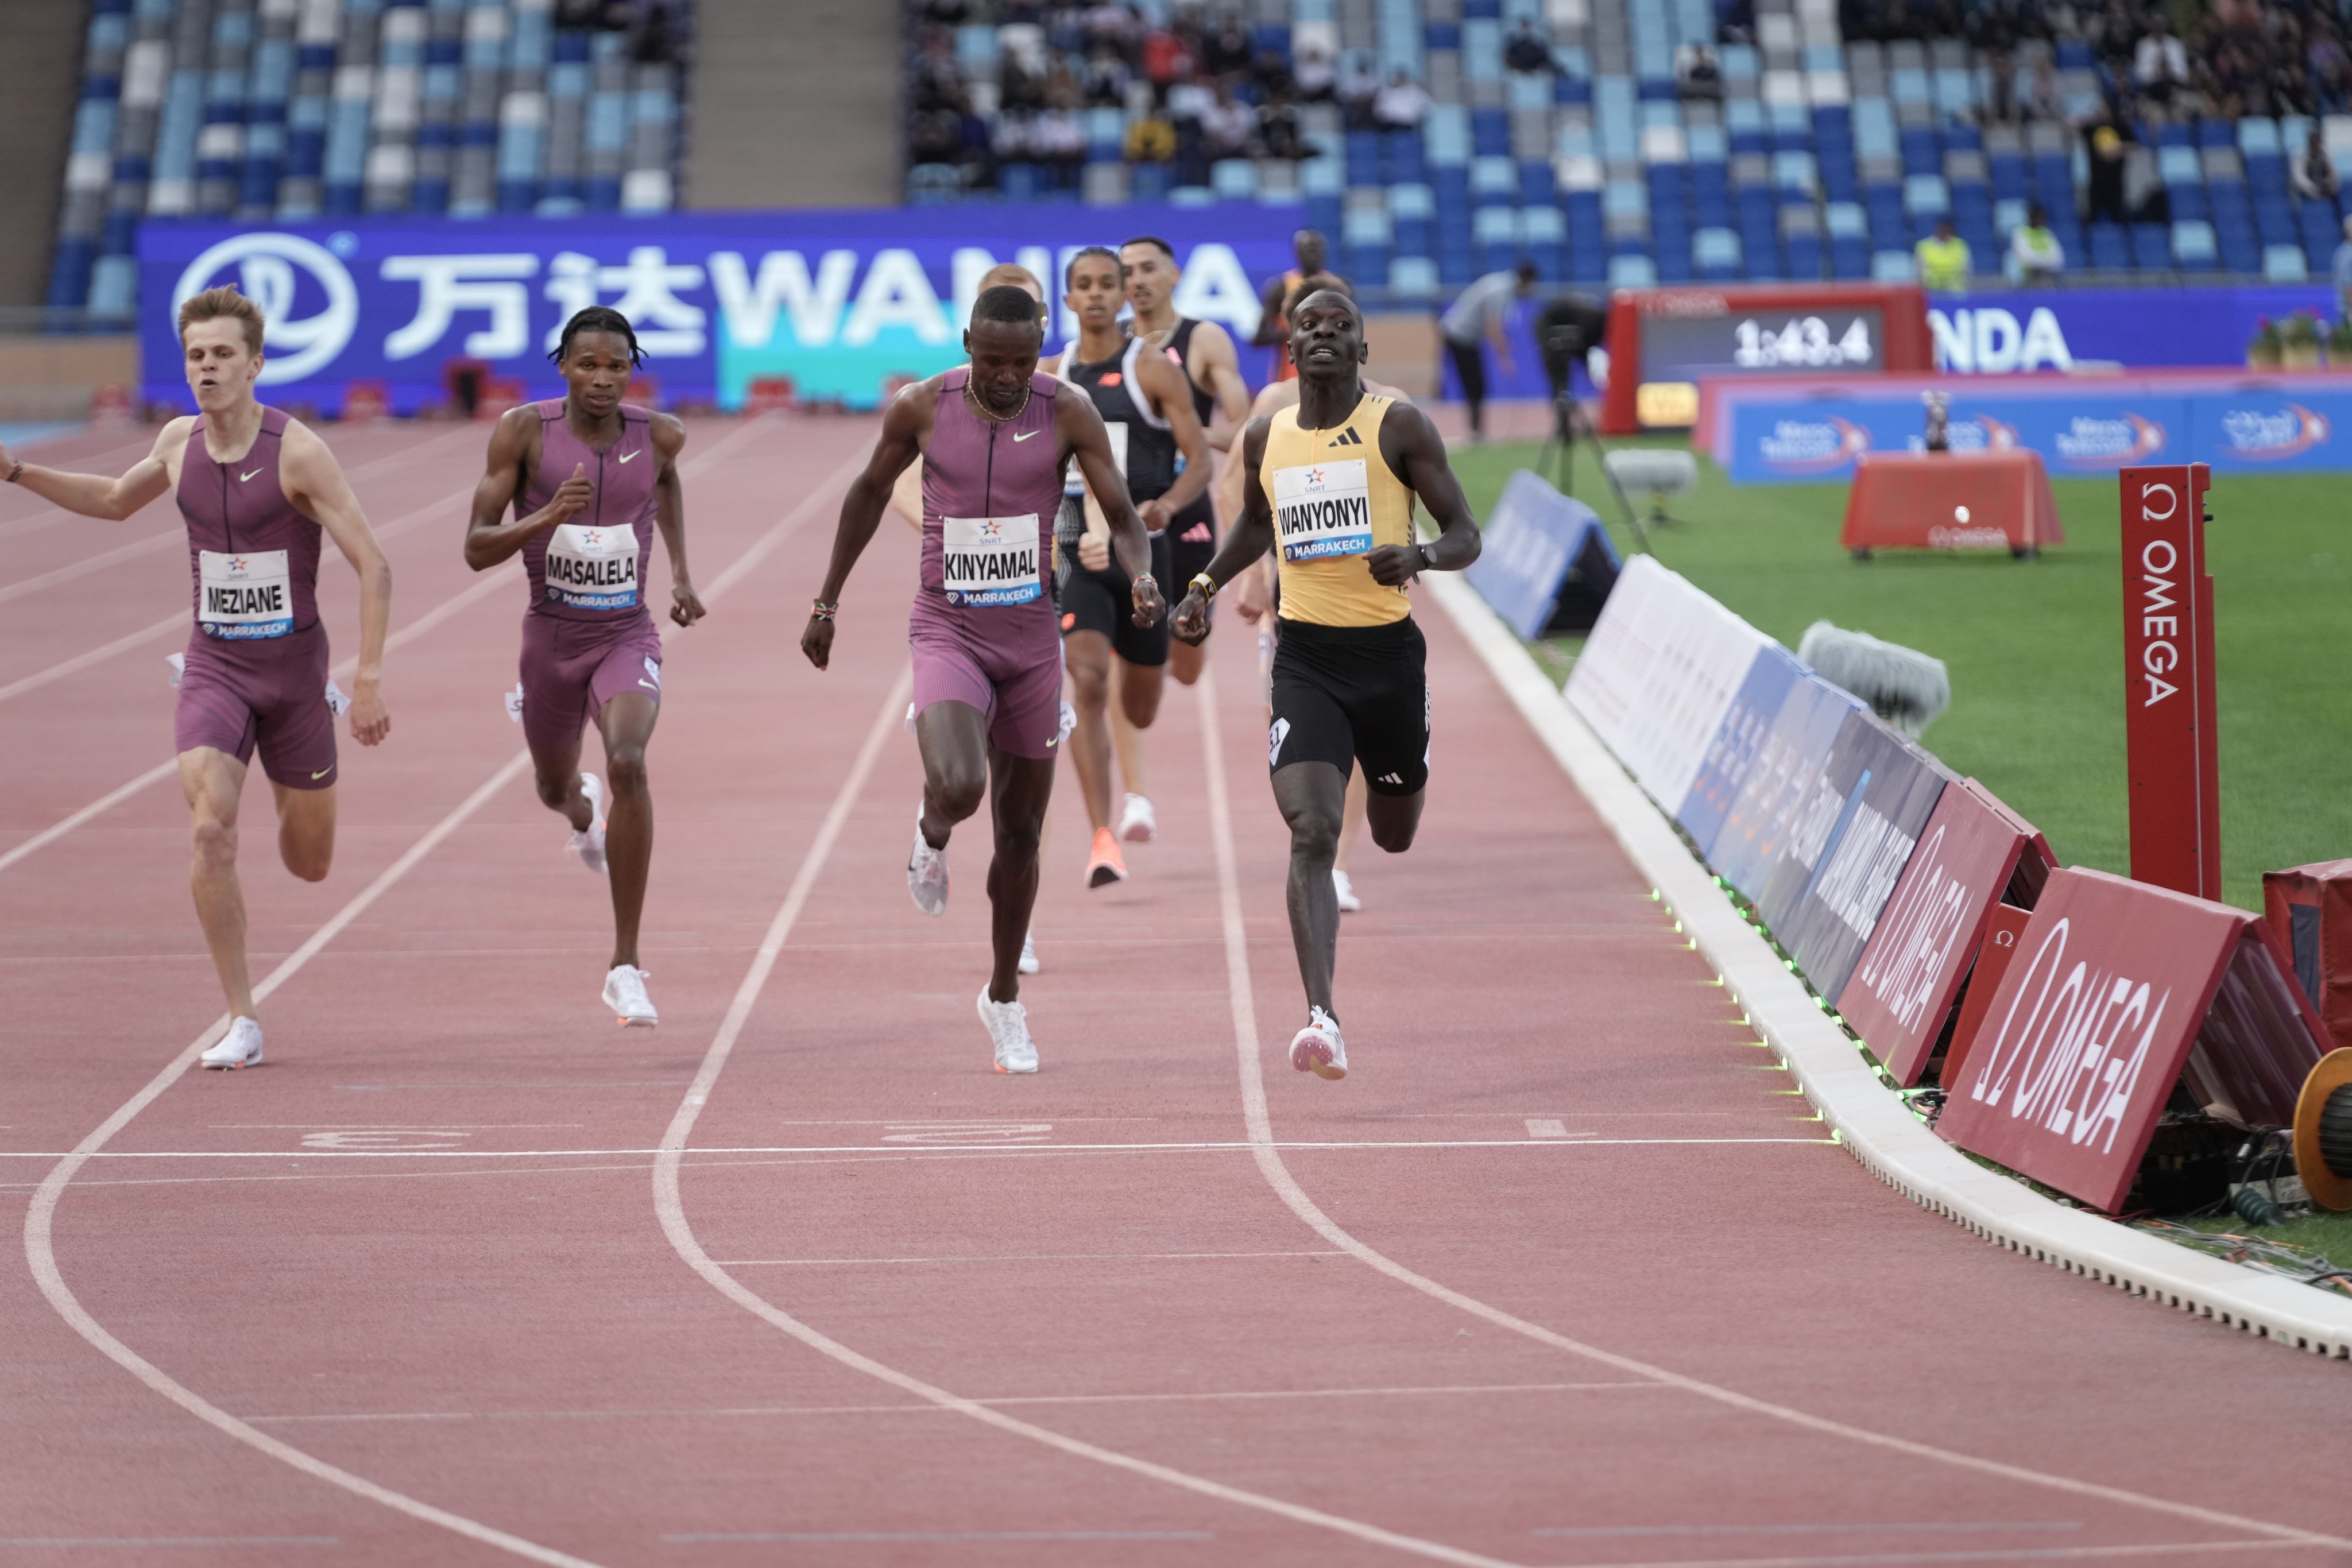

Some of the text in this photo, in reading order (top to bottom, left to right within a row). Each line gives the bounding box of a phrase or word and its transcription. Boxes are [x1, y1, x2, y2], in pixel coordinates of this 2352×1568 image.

[1734, 316, 1873, 367] 1:43.4
[1305, 485, 1326, 493] SNRT
[1278, 496, 1368, 536] WANYONYI
[980, 537, 1002, 545] SNRT
[1295, 538, 1365, 557] MARRAKECH
[548, 554, 635, 586] MASALELA
[945, 548, 1036, 581] KINYAMAL
[208, 584, 283, 614] MEZIANE
[562, 593, 631, 607] MARRAKECH
[964, 587, 1034, 604] MARRAKECH
[218, 622, 287, 637] MARRAKECH
[2142, 540, 2179, 707] OMEGA
[1843, 823, 1916, 943] LEAGUE
[1876, 864, 1975, 1035] OMEGA
[2012, 961, 2172, 1155] OMEGA
